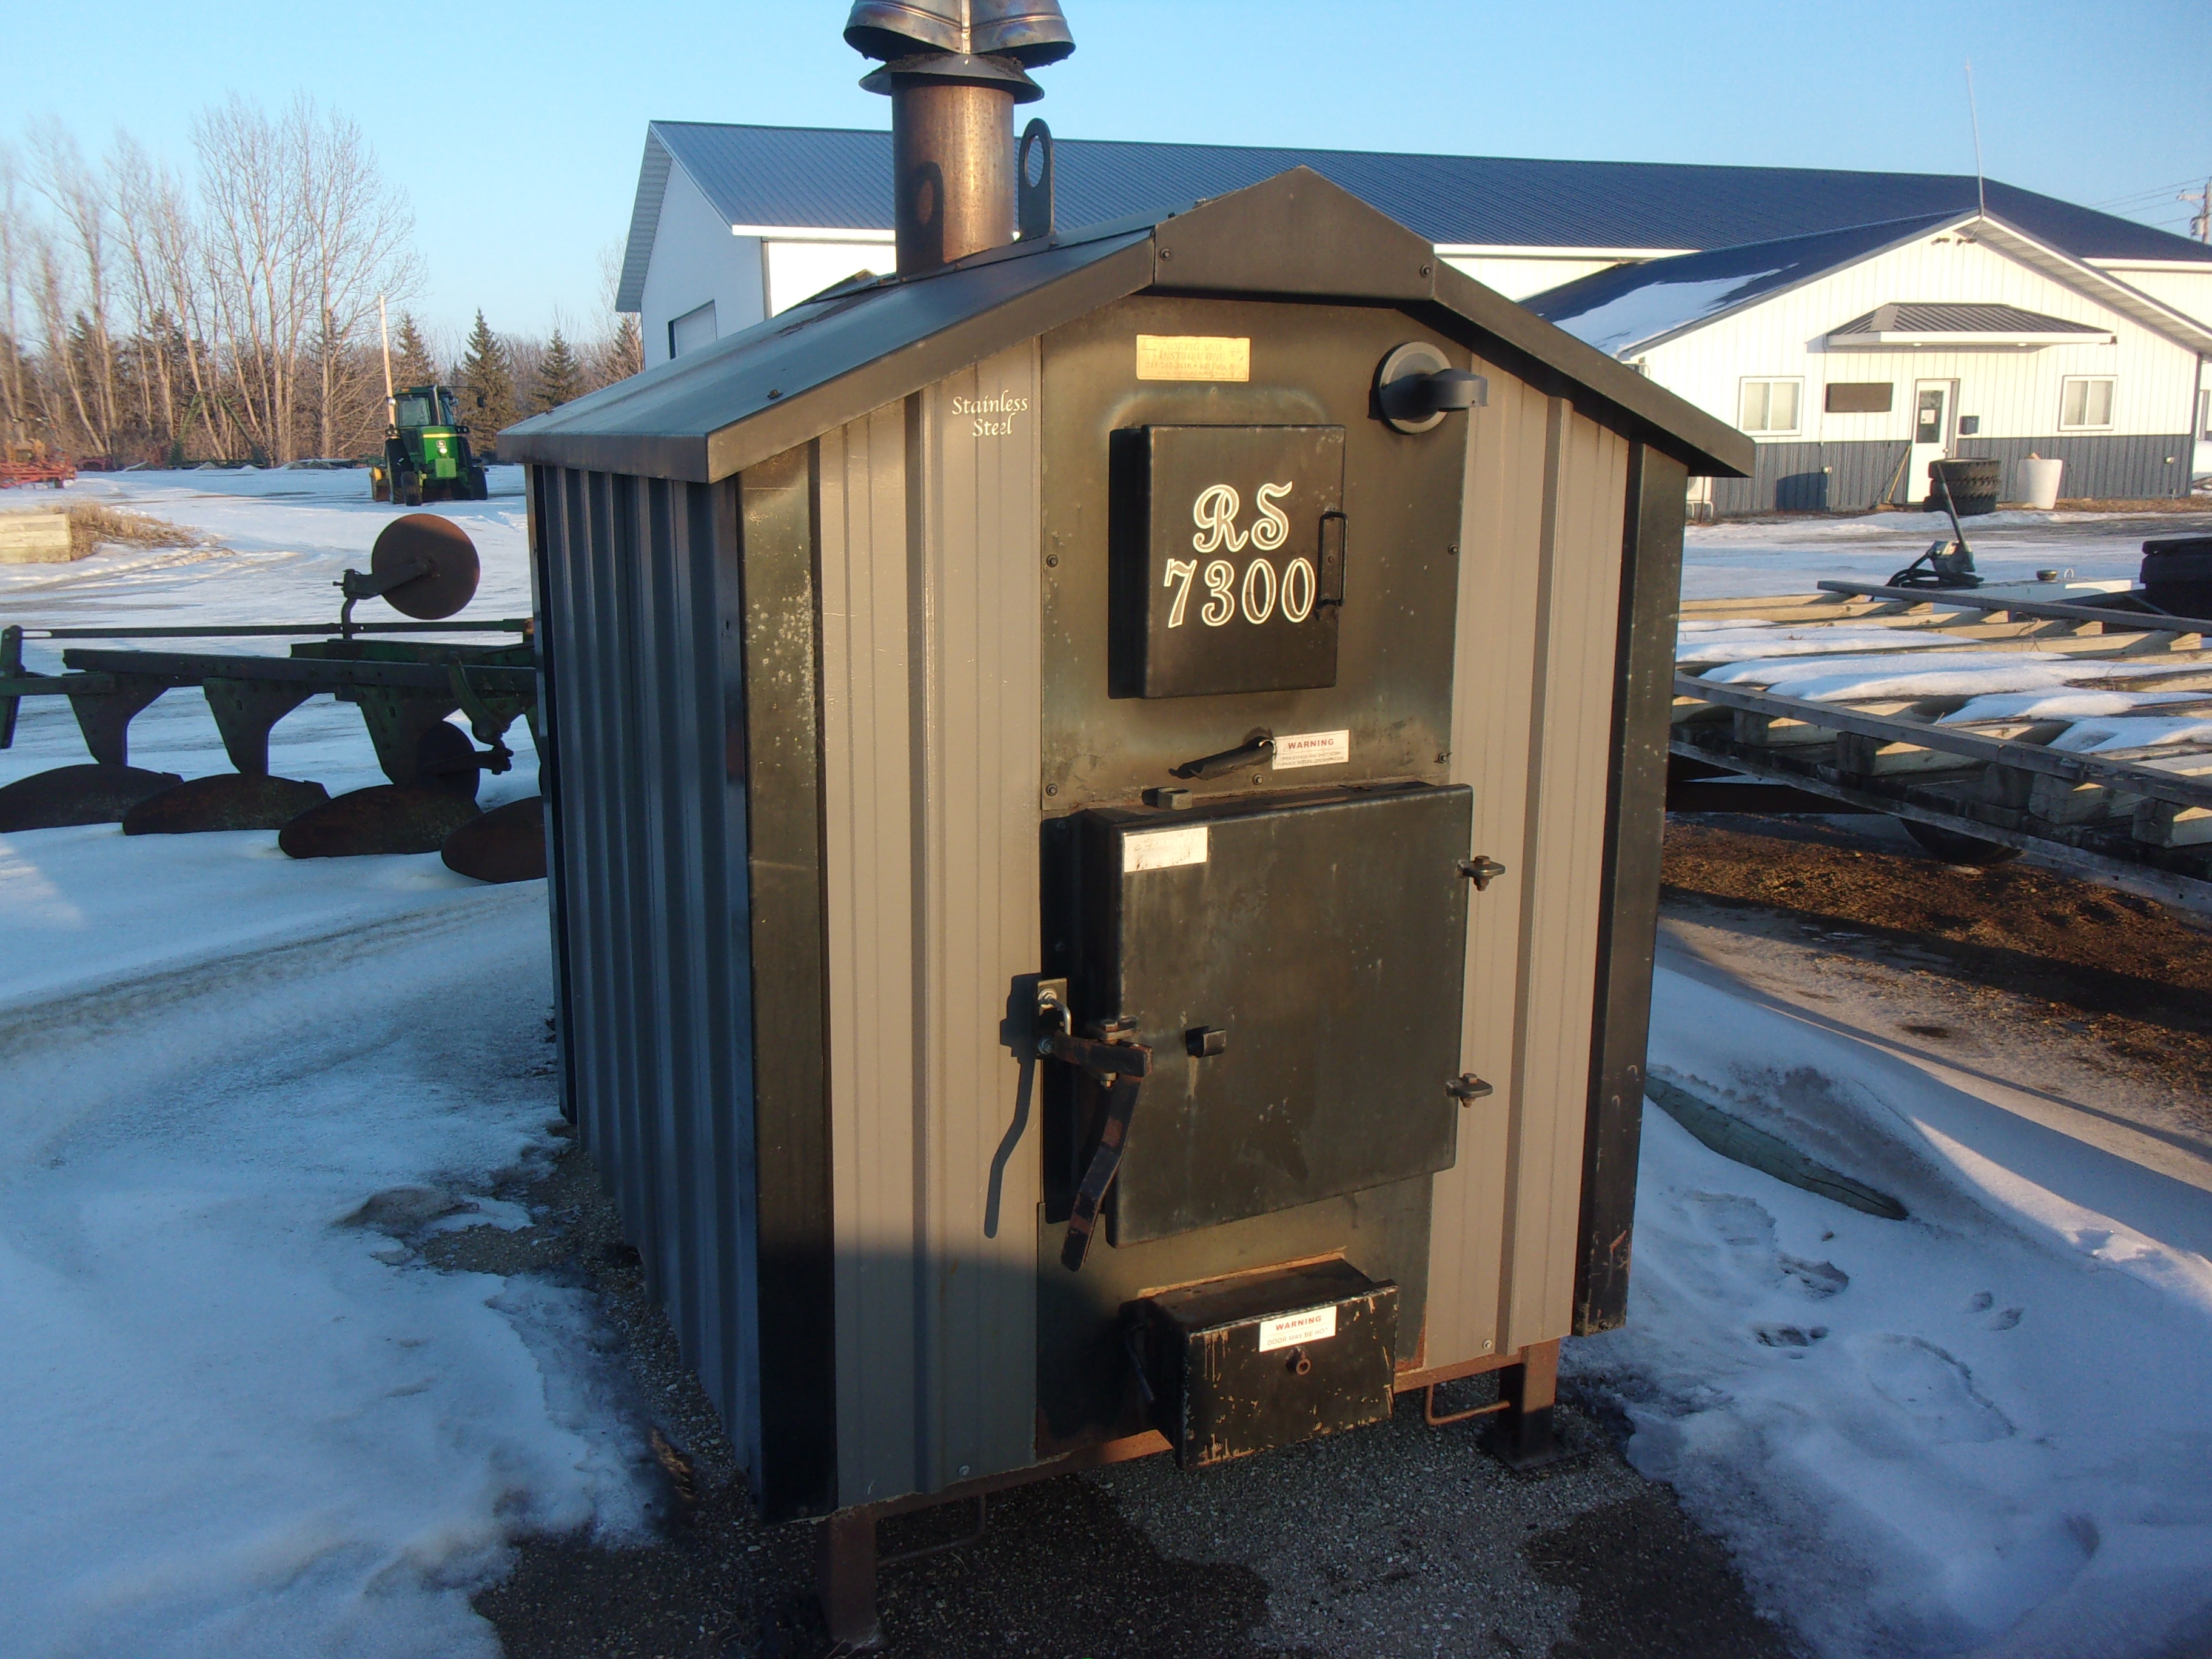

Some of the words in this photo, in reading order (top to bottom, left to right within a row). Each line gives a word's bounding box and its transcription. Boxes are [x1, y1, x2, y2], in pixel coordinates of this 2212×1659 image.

[1159, 350, 1226, 361] DISTRIBUTING
[951, 389, 1028, 415] Stainless
[972, 412, 1016, 437] Steel
[1193, 481, 1293, 553] RS
[1164, 557, 1316, 628] 7300
[1288, 739, 1334, 750] WARNING
[1276, 1316, 1322, 1331] WARNING
[1267, 1336, 1287, 1346] DOOR
